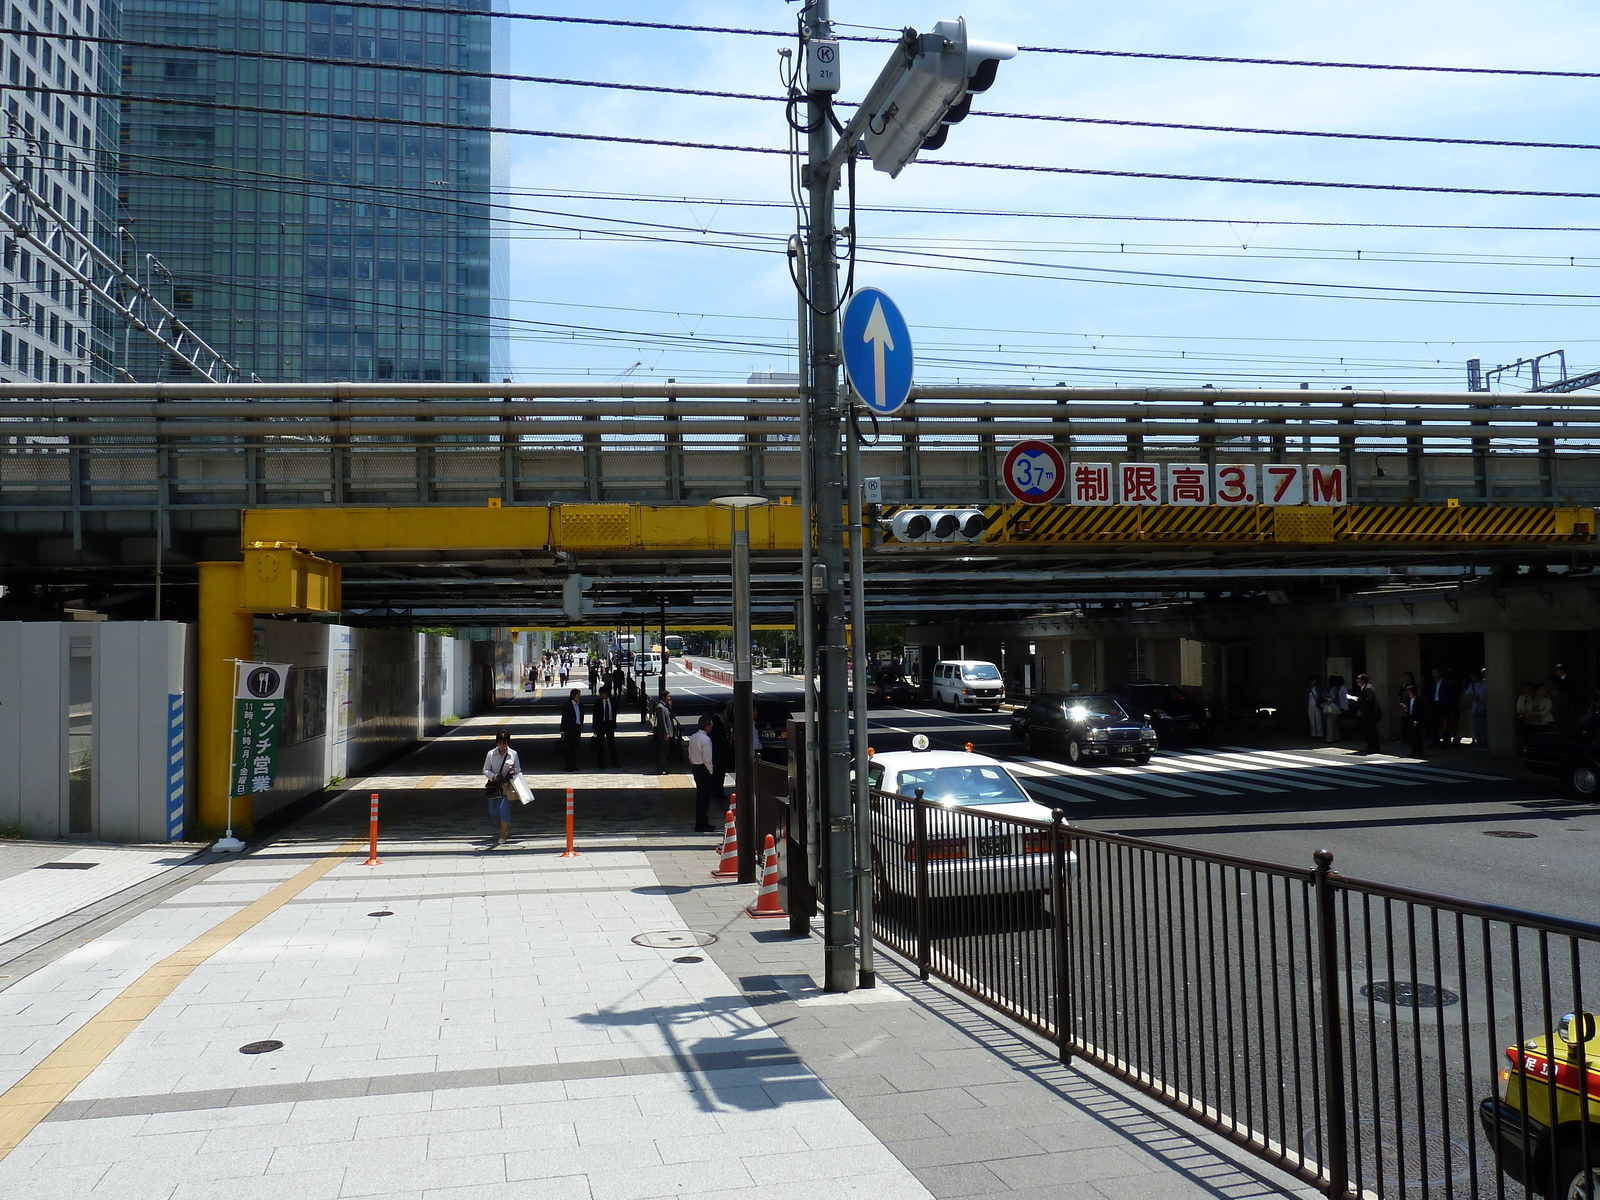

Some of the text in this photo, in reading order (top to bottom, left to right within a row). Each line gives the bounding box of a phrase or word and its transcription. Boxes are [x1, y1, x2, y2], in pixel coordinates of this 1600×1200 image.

[251, 702, 276, 793] ランチ営業
